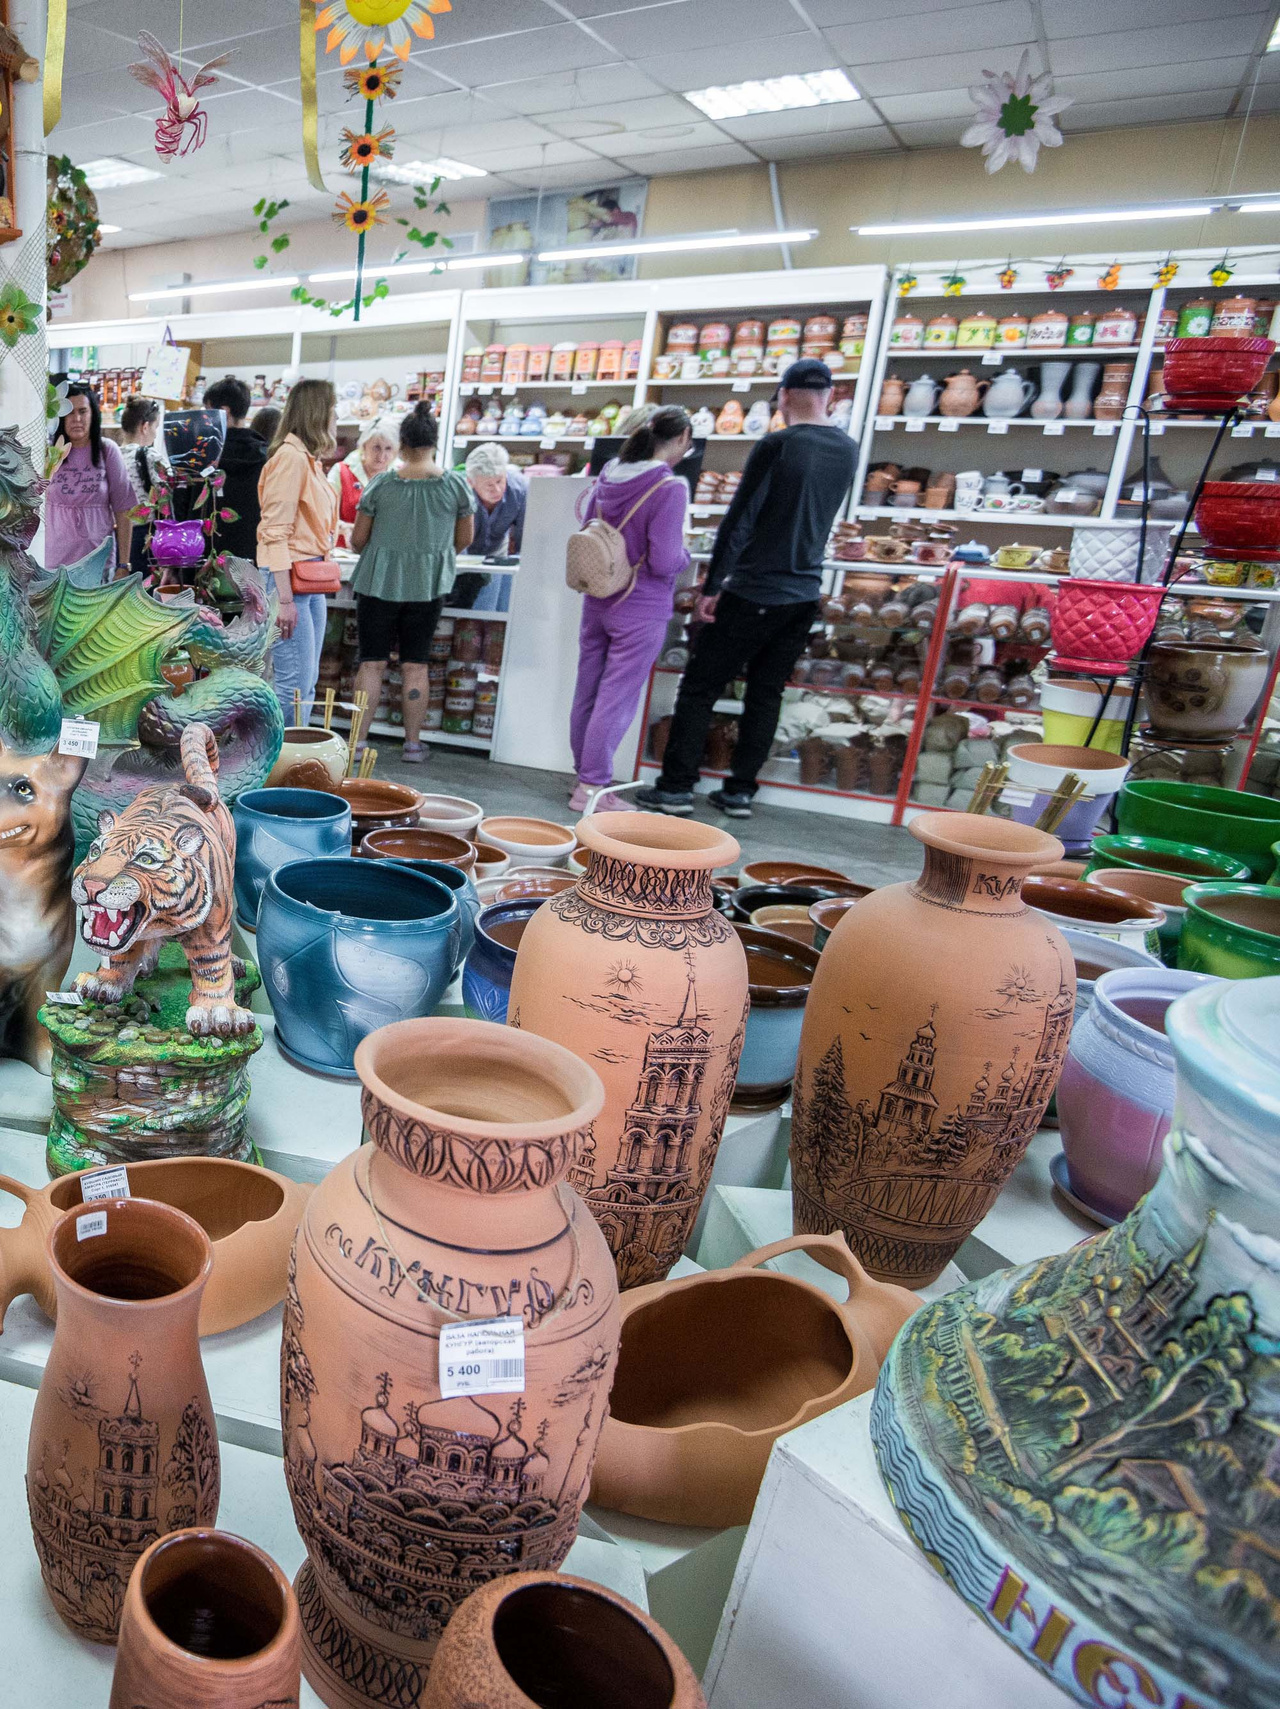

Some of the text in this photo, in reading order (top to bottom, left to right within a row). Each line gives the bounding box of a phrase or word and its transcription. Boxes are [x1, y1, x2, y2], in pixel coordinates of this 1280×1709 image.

[445, 1340, 473, 1348] КУНГУР
[447, 1364, 481, 1377] 5 400
